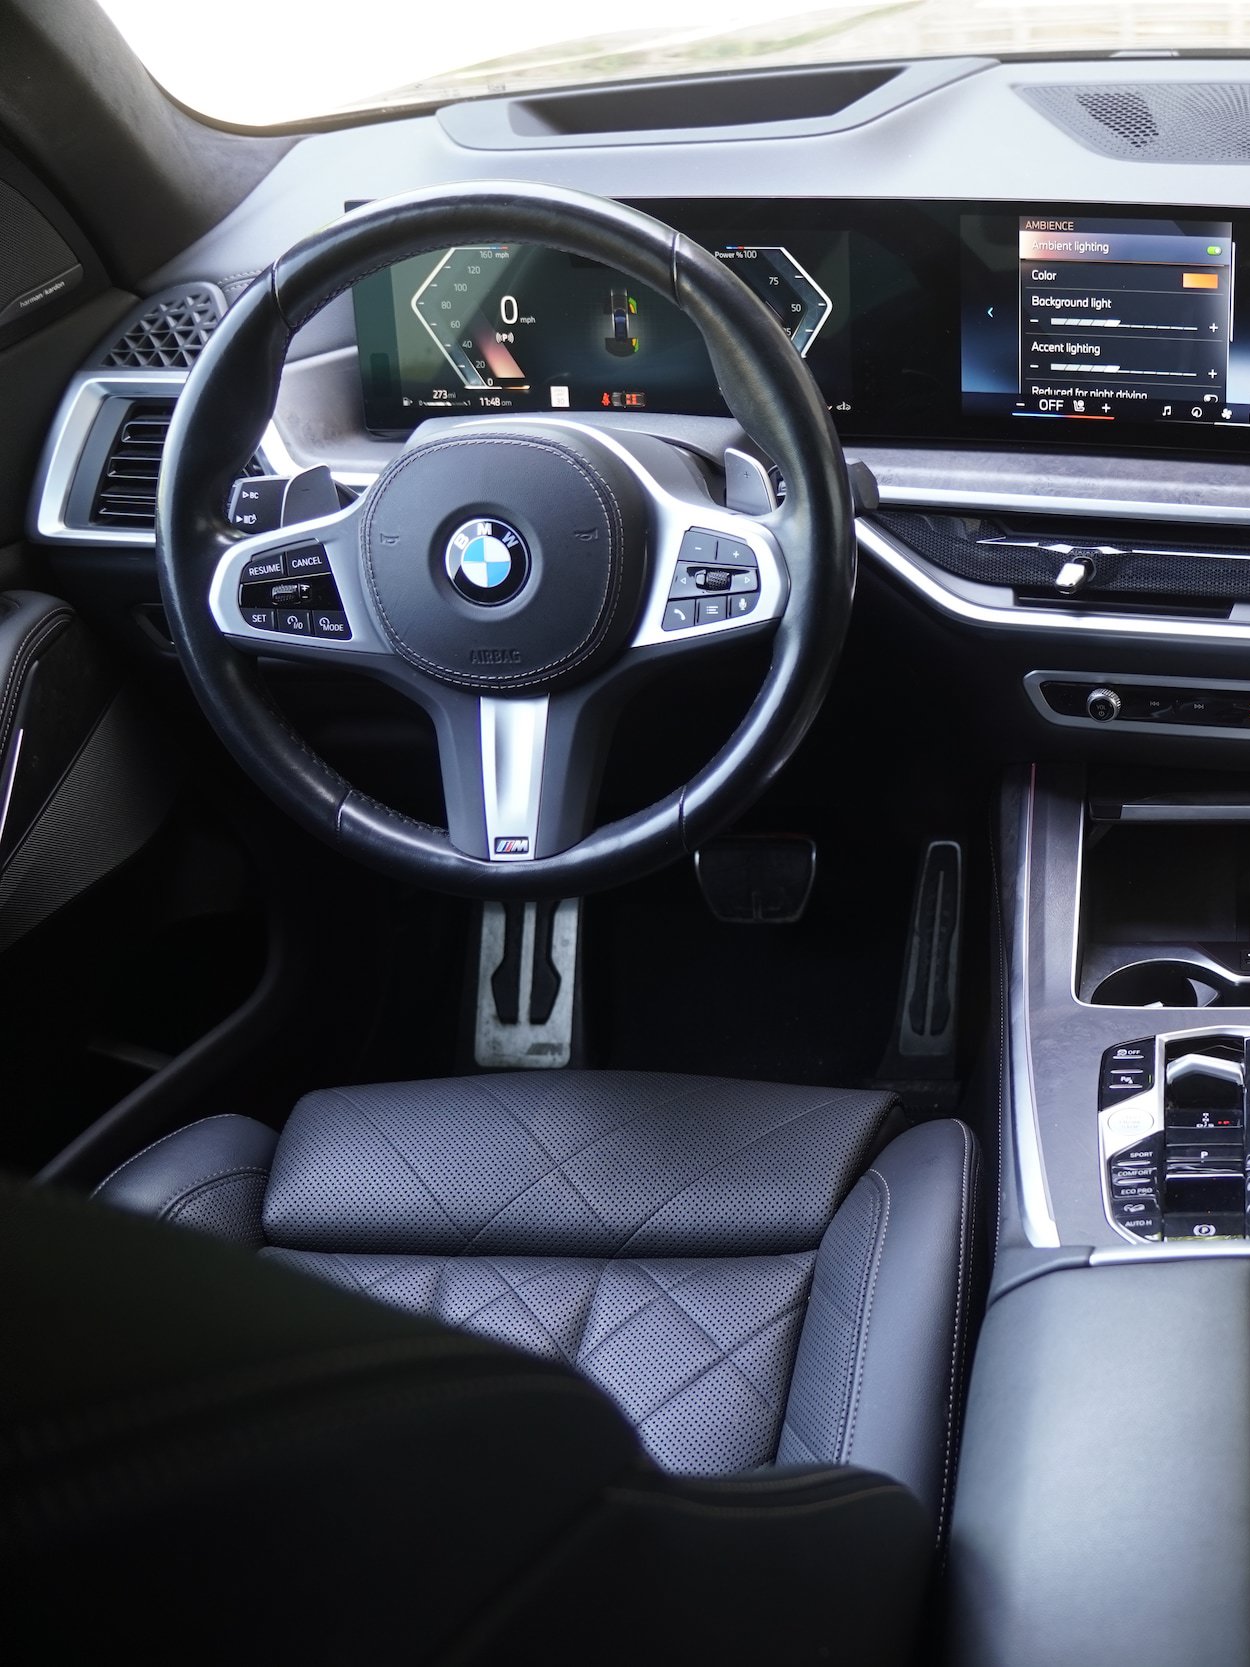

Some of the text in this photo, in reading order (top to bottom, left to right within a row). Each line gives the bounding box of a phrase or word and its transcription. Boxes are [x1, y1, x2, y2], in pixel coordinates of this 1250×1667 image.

[1025, 220, 1074, 231] AMBIENCE
[1032, 240, 1109, 255] Ambient lighting
[480, 250, 510, 259] 160 mph
[467, 265, 481, 274] 120
[1031, 269, 1057, 281] Color
[768, 276, 779, 286] 75
[454, 283, 468, 292] 100
[441, 301, 452, 309] 80
[791, 303, 801, 312] 50
[1032, 295, 1112, 311] Background light
[500, 294, 536, 325] 0 mph
[450, 320, 461, 329] 60
[462, 340, 472, 348] 40
[1031, 341, 1101, 356] Accent lighting
[475, 360, 486, 369] 20
[487, 377, 494, 387] 0
[432, 389, 448, 399] 273
[1075, 387, 1088, 398] for
[479, 397, 501, 407] 11:48
[1038, 398, 1065, 411] OFF
[249, 491, 259, 499] BC
[453, 522, 519, 550] BMW
[291, 555, 323, 569] CANCEL
[248, 563, 281, 576] RESUME
[252, 614, 267, 623] SET
[322, 623, 344, 632] MODE
[471, 649, 521, 664] AIRBAG
[1200, 1151, 1209, 1159] P
[1117, 1169, 1153, 1177] COMFORT
[1125, 1219, 1145, 1227] AUTO
